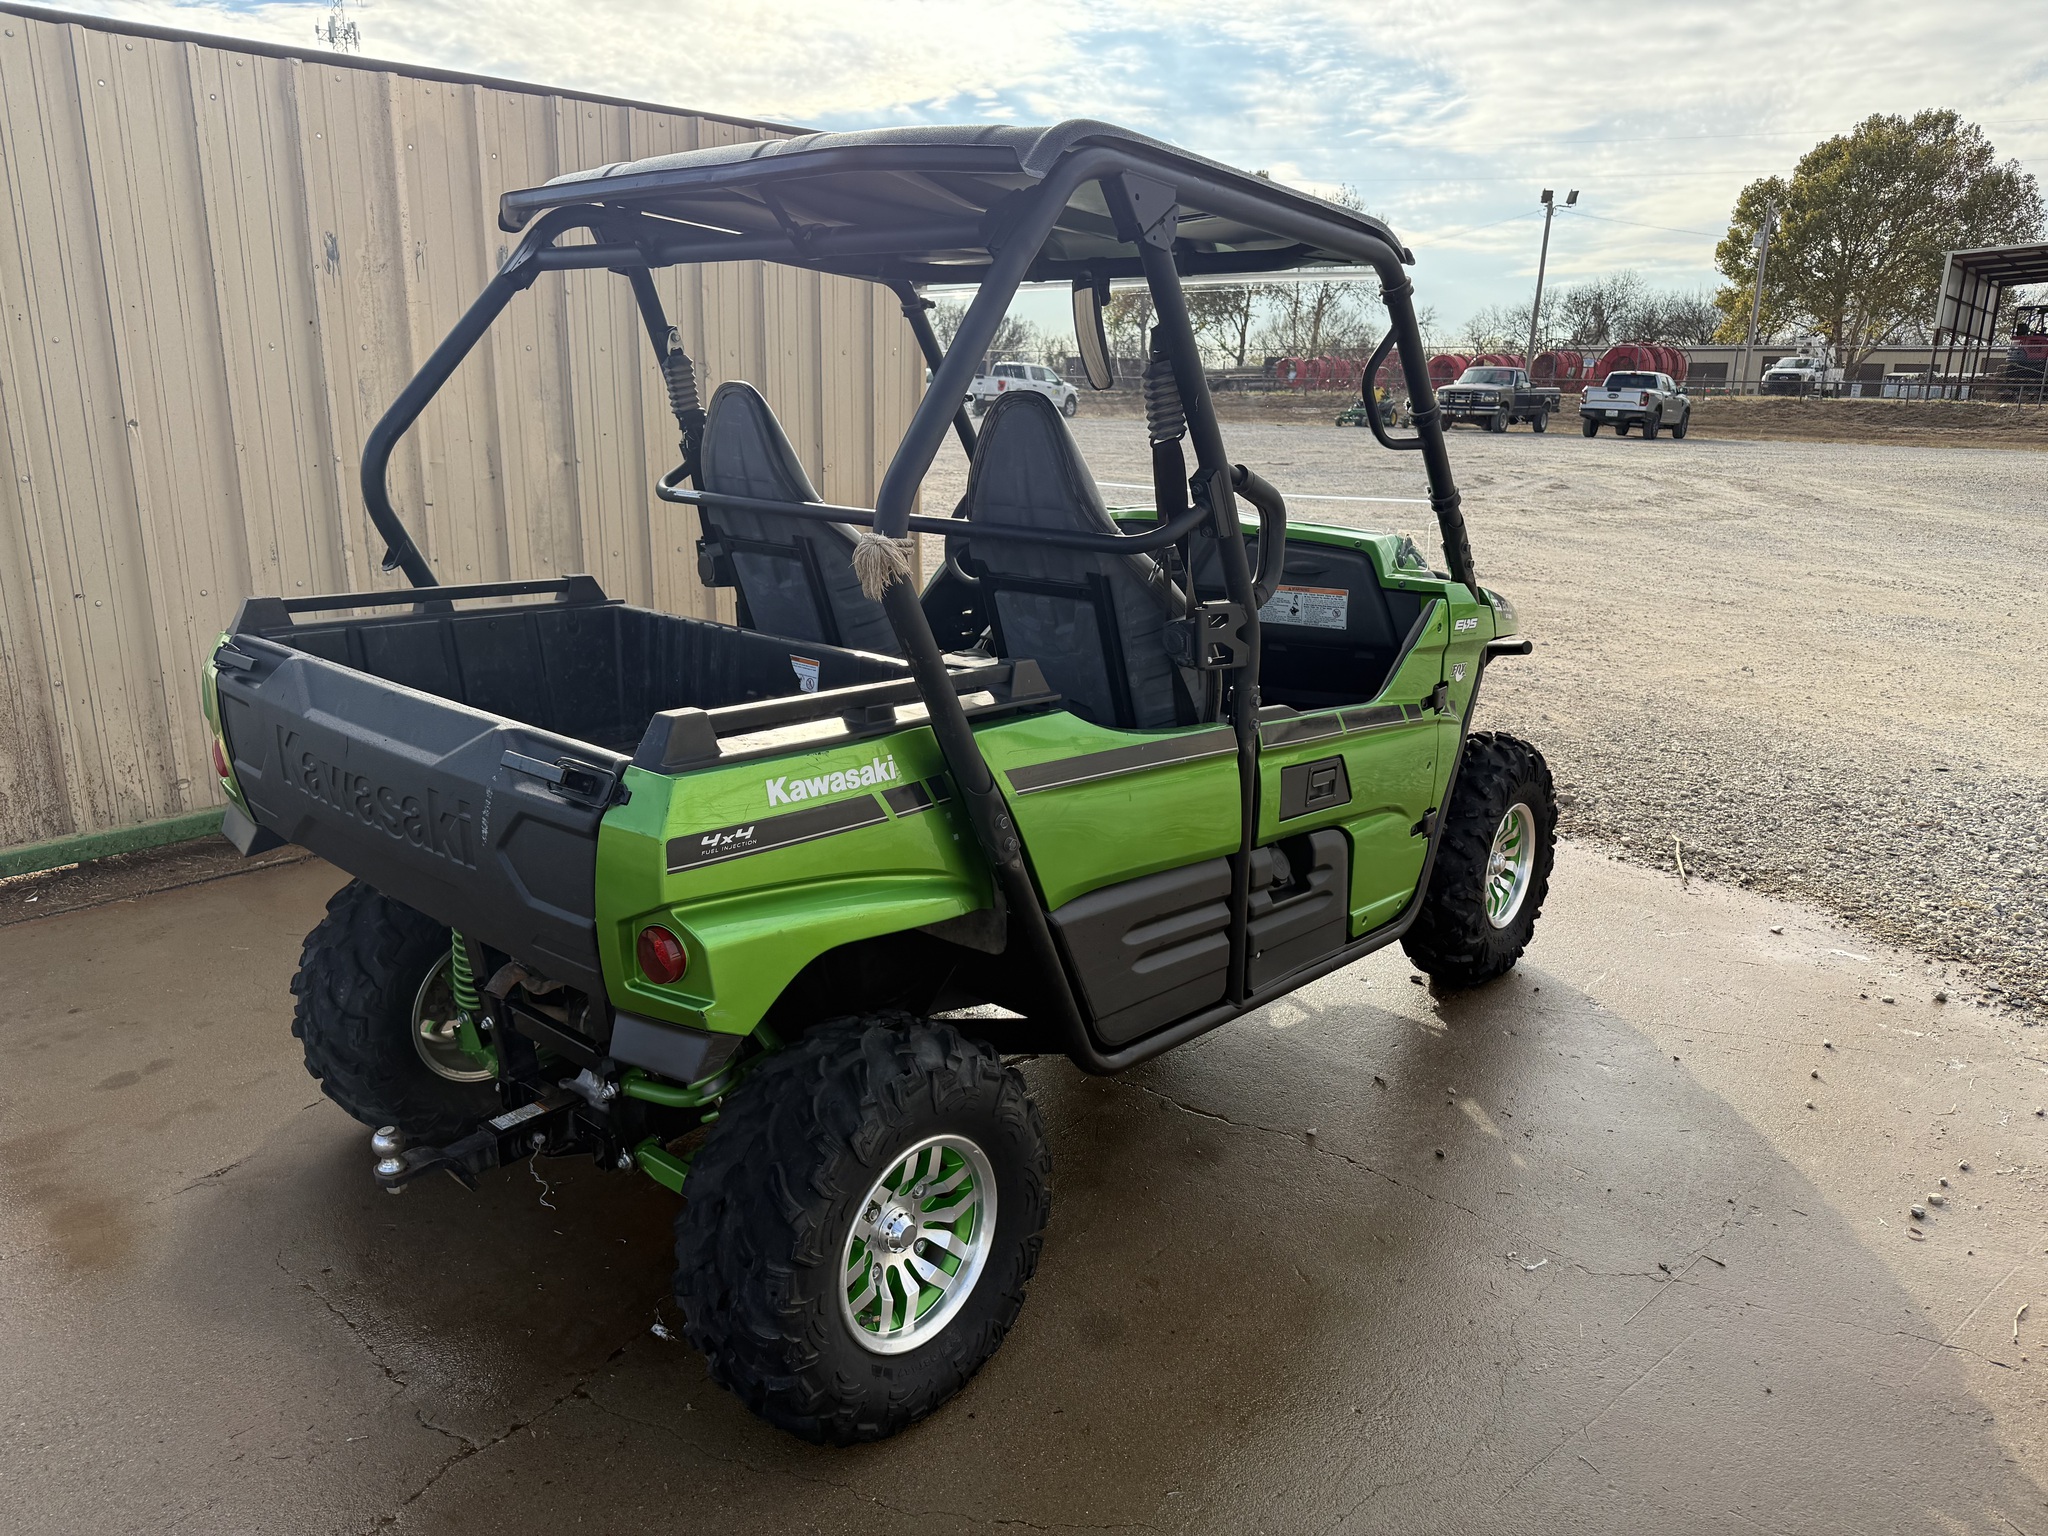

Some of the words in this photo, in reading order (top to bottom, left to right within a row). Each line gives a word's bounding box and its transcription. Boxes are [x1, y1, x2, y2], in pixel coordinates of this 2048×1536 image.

[276, 724, 478, 870] Kawasaki
[765, 754, 897, 807] Kawasaki
[701, 825, 755, 847] 4x4
[701, 848, 719, 856] FUEL
[721, 839, 758, 852] INJECTION
